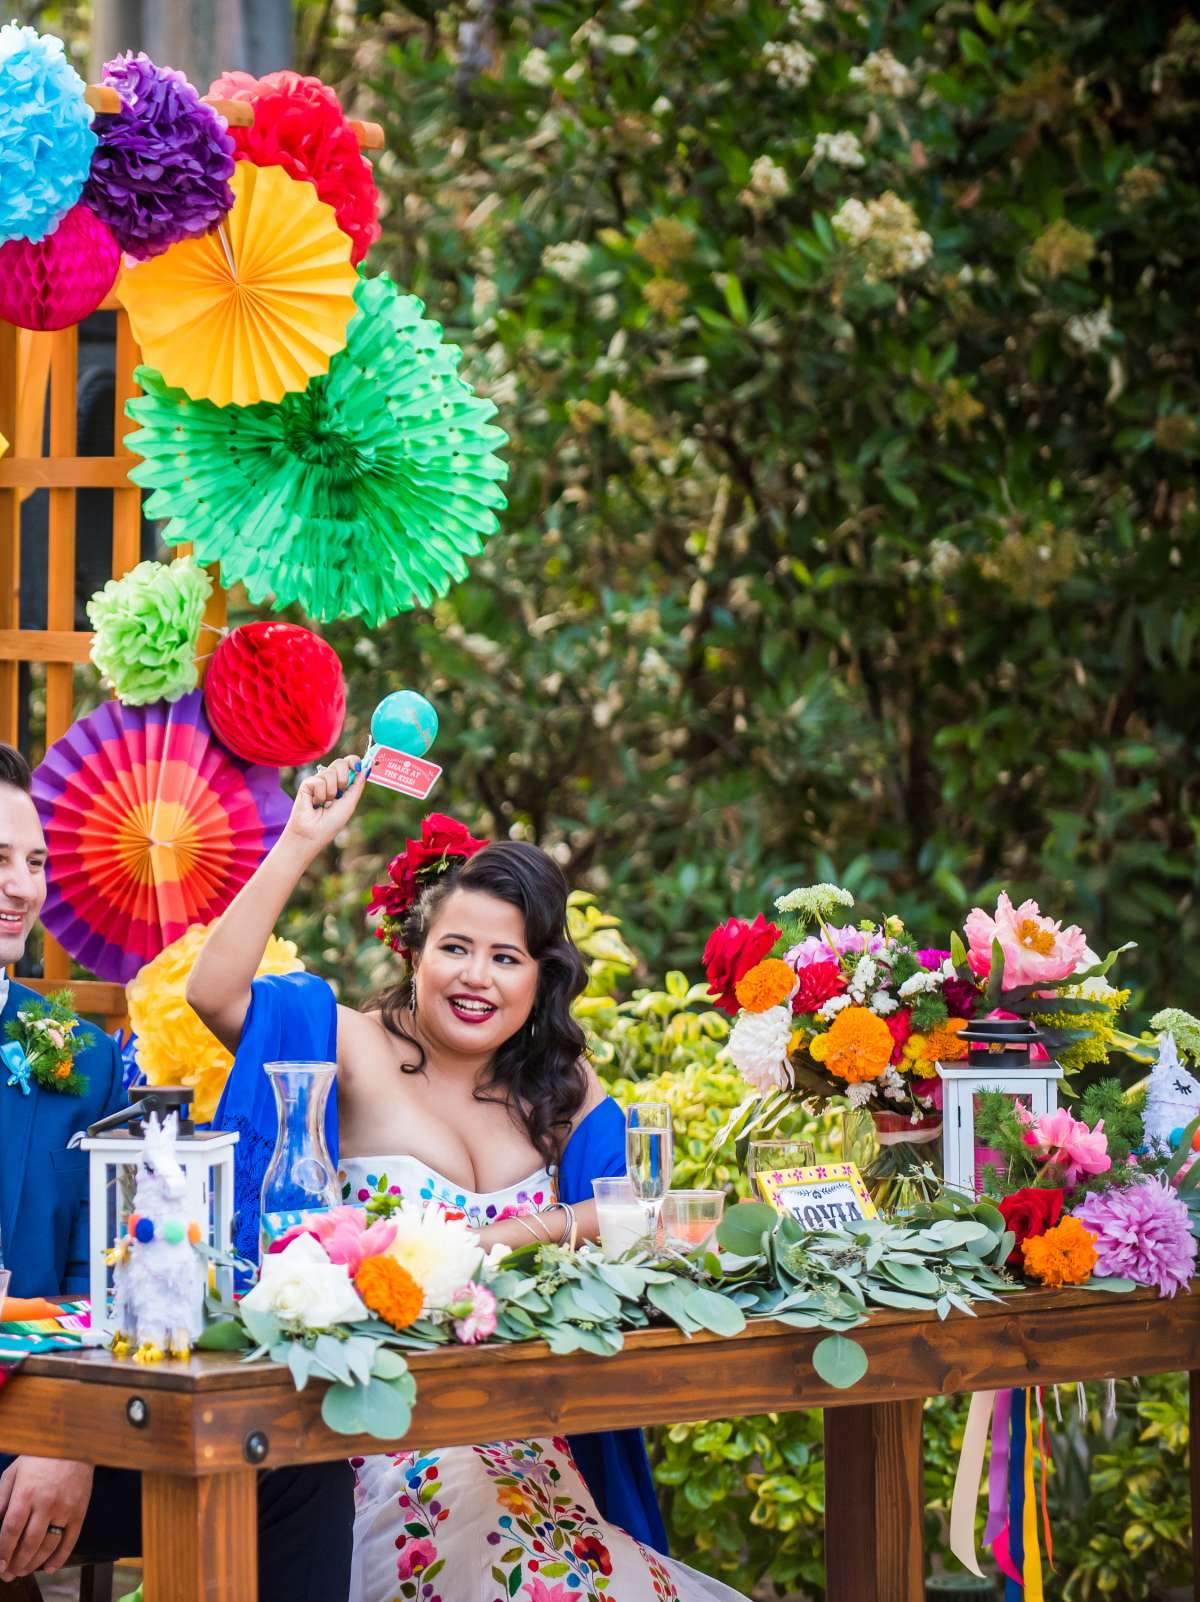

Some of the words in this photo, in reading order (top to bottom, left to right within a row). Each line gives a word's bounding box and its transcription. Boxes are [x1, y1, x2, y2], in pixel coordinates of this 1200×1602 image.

[385, 769, 397, 779] THE
[387, 761, 410, 775] SHAKE
[410, 770, 420, 778] AT
